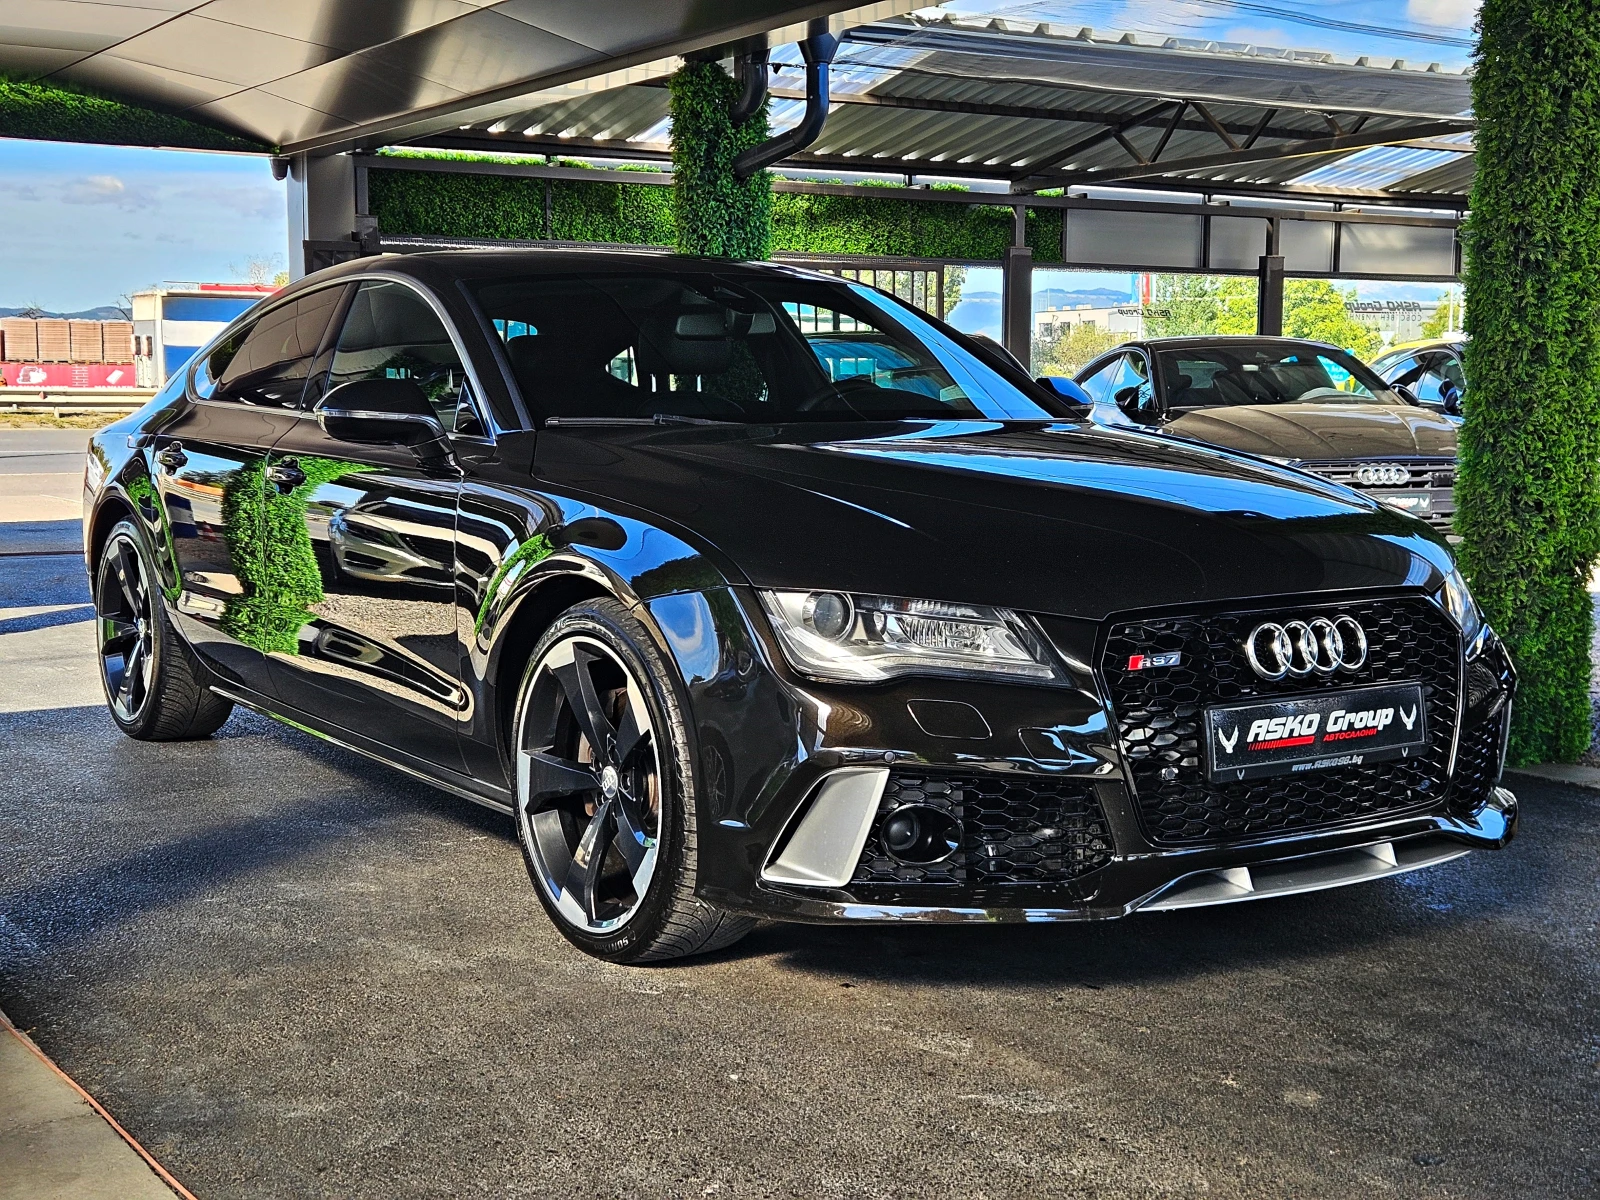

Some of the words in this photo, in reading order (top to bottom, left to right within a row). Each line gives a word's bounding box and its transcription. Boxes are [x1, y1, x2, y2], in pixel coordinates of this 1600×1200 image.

[1137, 654, 1179, 668] RS7
[1246, 713, 1320, 743] ASKO
[1326, 707, 1395, 733] Group
[1323, 728, 1378, 742] АВТОСАЛОНИ
